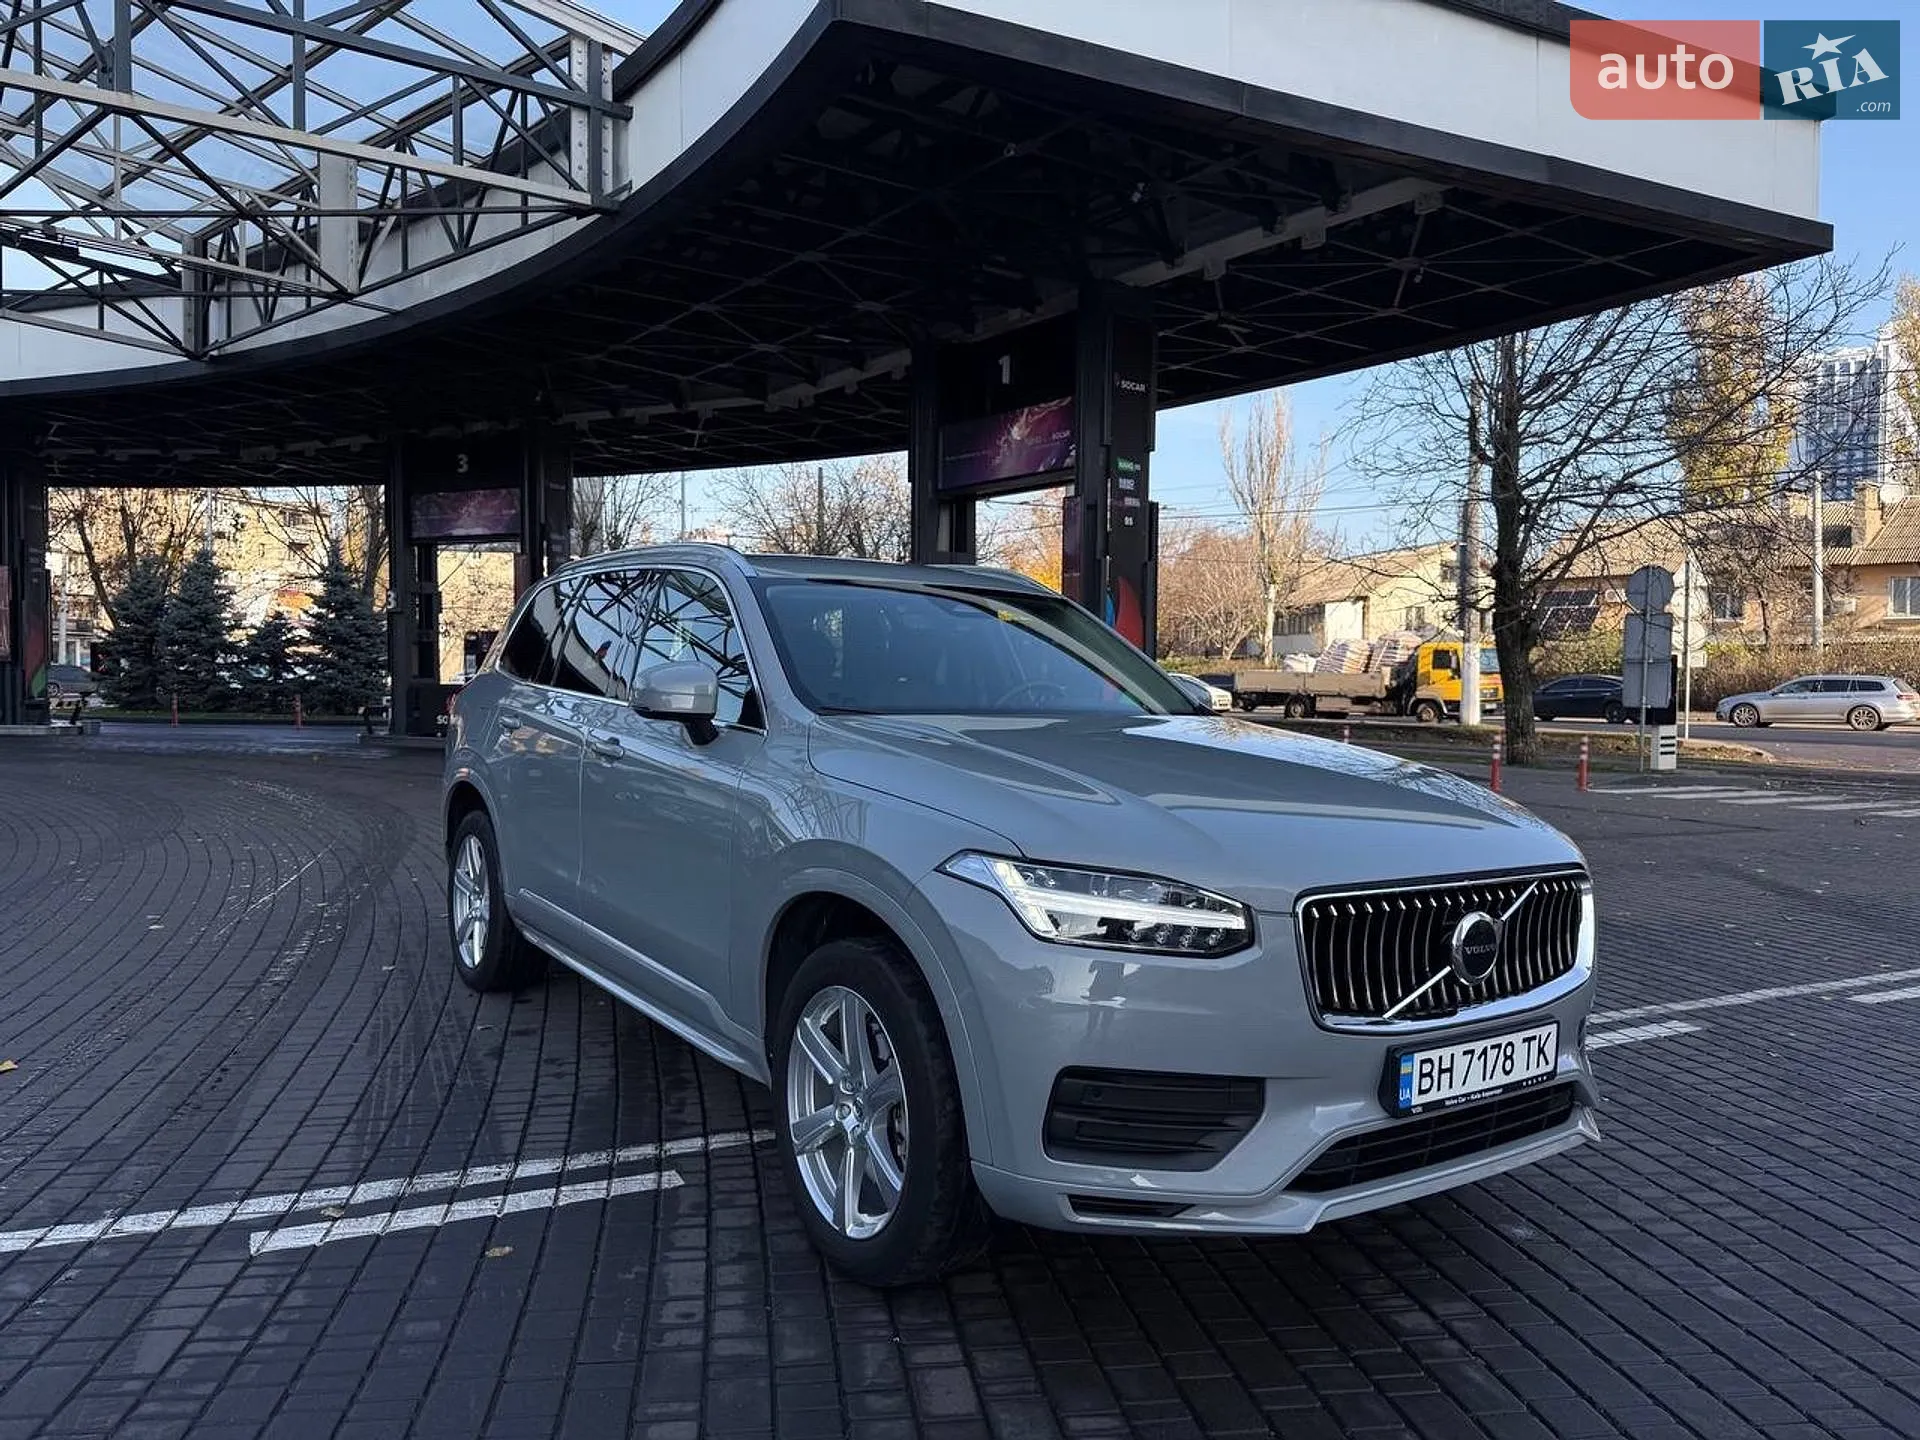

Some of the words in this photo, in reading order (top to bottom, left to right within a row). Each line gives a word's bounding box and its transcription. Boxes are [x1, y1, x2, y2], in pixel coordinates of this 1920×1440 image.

[998, 355, 1011, 385] 1
[1121, 380, 1146, 392] SOCAR
[456, 453, 469, 473] 3
[1464, 944, 1497, 954] VOLVO
[1418, 1053, 1454, 1095] BH
[1461, 1041, 1515, 1086] 7178
[1522, 1032, 1552, 1071] TK
[1399, 1088, 1412, 1101] UA
